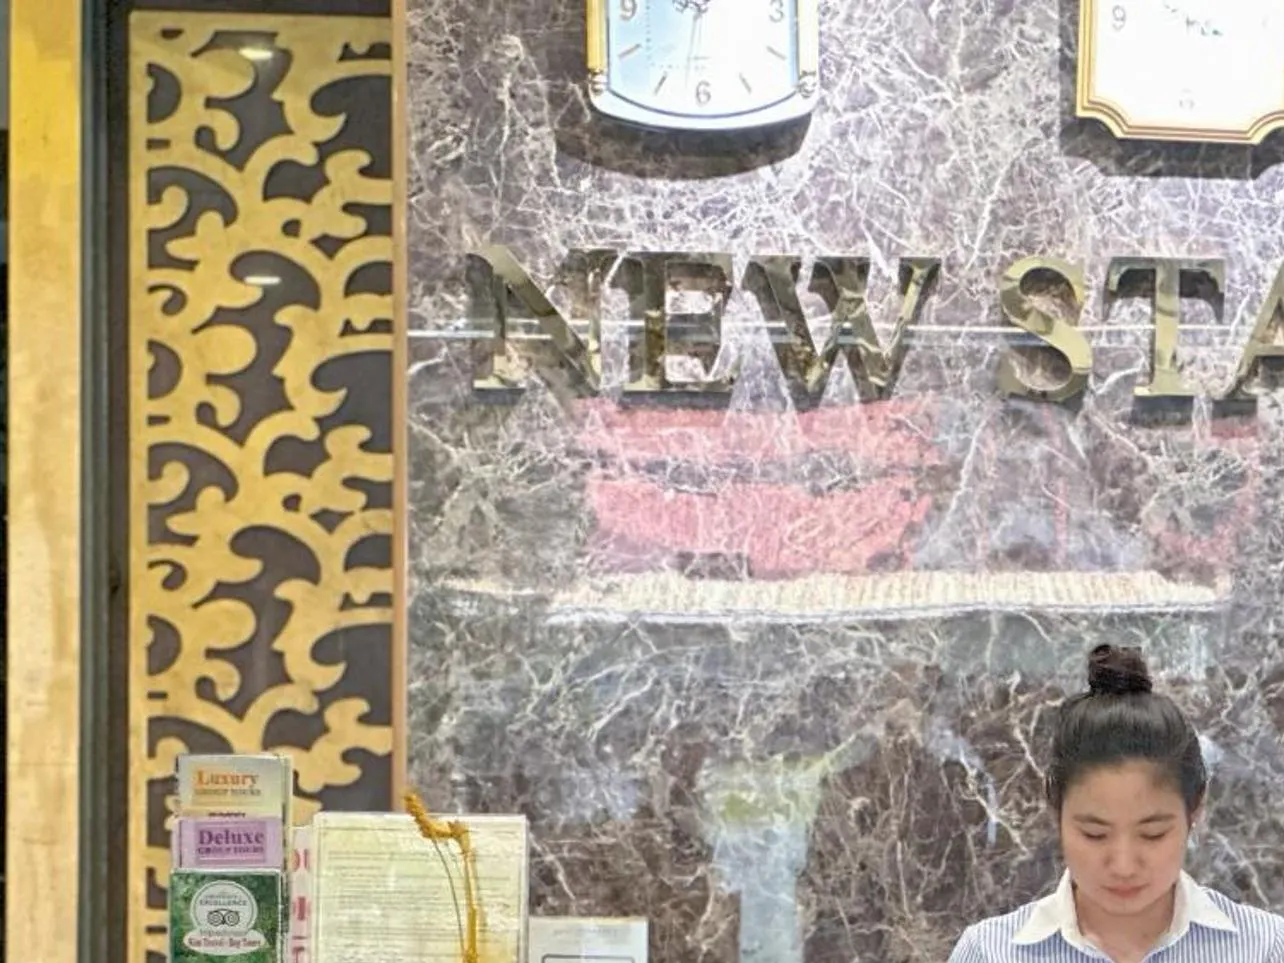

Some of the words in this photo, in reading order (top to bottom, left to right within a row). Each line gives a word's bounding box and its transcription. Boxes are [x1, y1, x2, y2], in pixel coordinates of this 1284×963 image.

[695, 81, 711, 104] 6
[466, 247, 941, 400] NEW
[194, 769, 260, 788] Luxury
[198, 829, 265, 845] Deluxe
